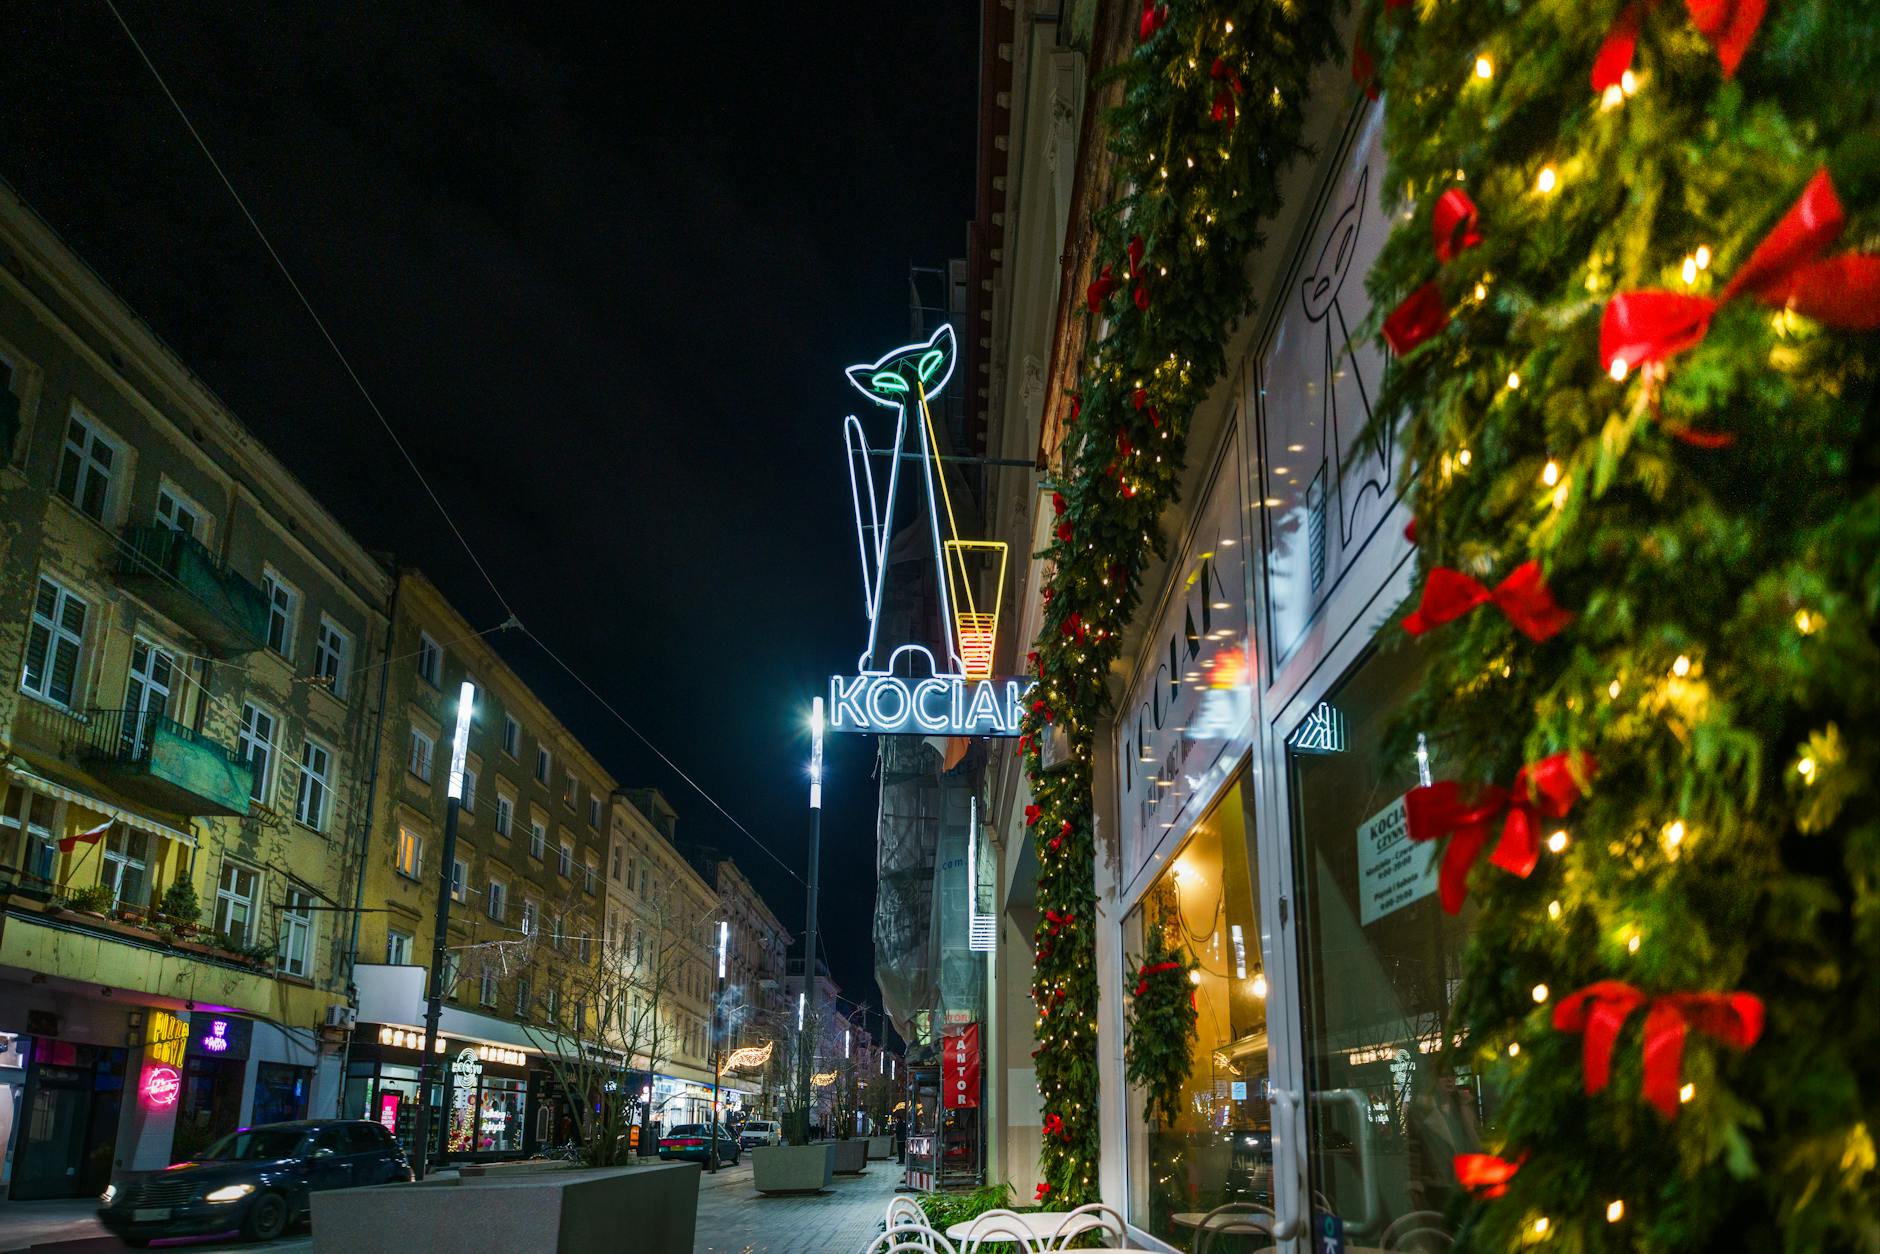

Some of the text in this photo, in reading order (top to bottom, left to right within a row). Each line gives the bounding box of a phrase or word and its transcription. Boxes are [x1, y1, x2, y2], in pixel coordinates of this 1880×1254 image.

[831, 675, 1040, 731] KOCIAK
[154, 1012, 190, 1042] PIZZA
[956, 1026, 967, 1105] KANTOR
